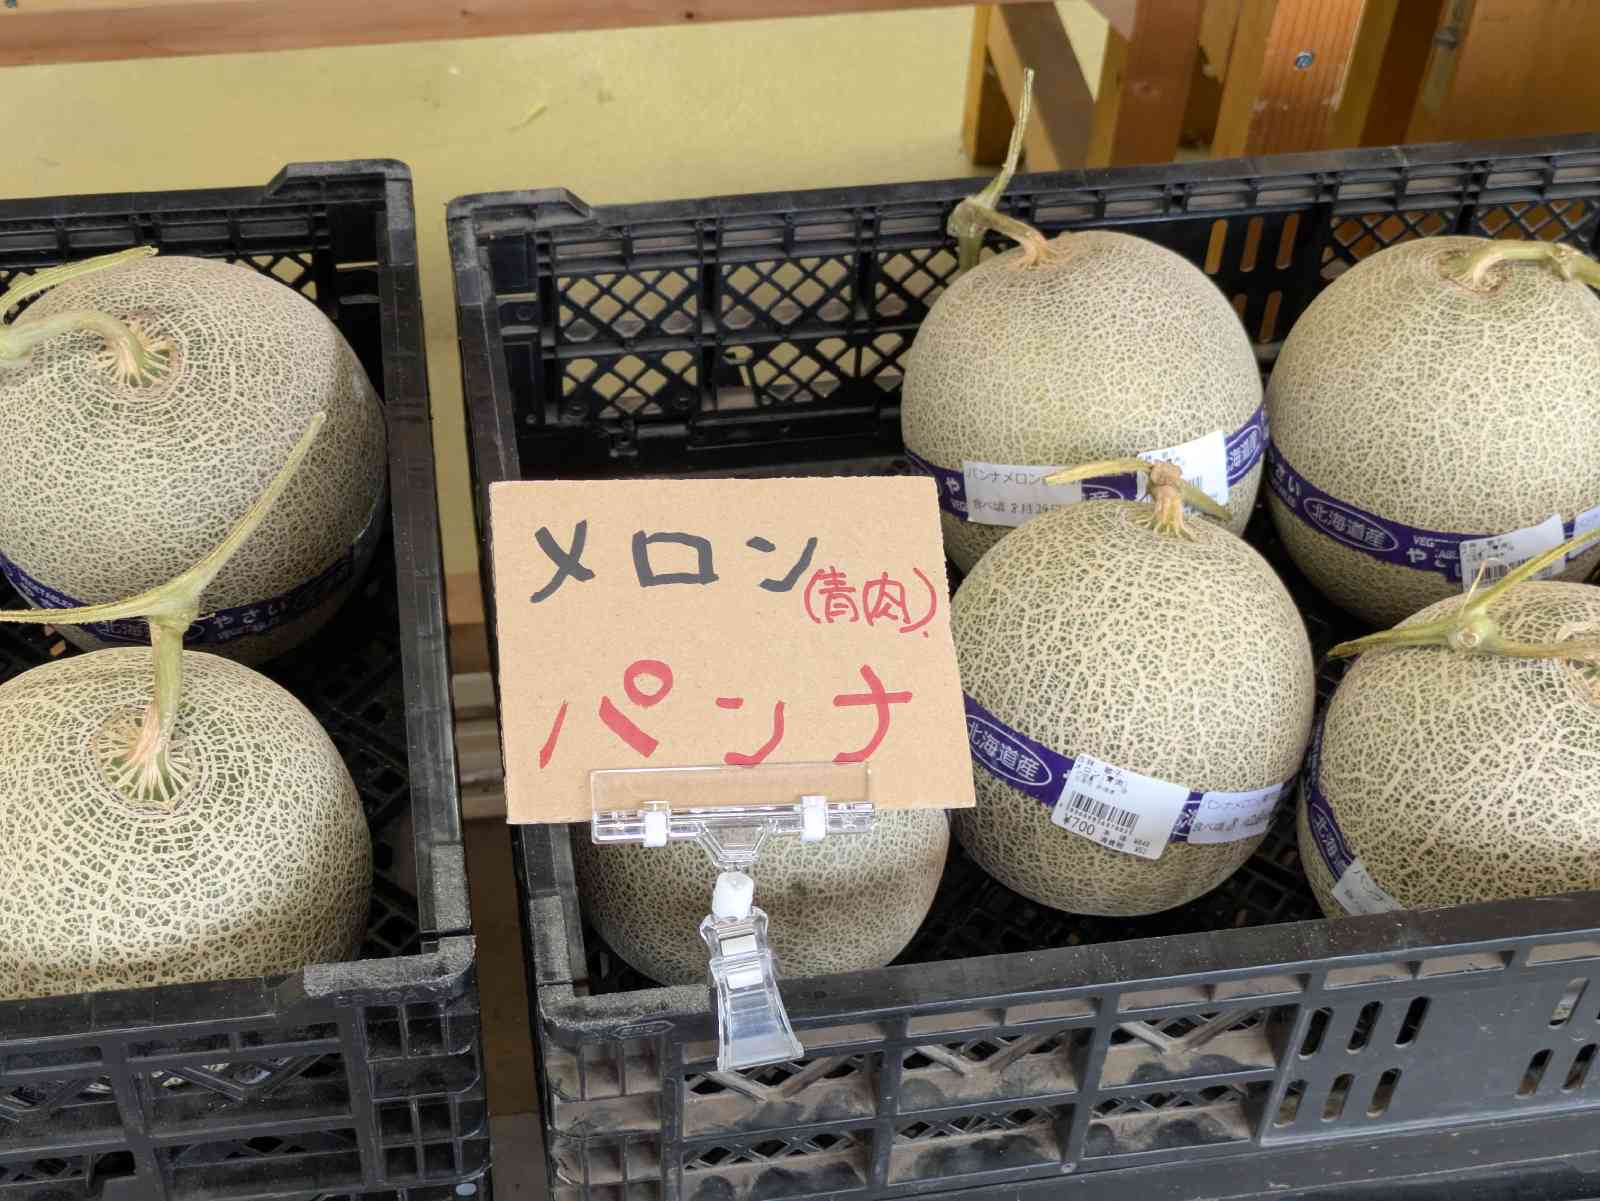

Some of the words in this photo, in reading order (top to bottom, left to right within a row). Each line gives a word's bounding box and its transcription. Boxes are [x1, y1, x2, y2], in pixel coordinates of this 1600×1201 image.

[529, 519, 818, 604] メロン
[538, 658, 914, 770] パンナ
[966, 721, 1041, 782] 北海道産
[1063, 812, 1096, 836] ¥700
